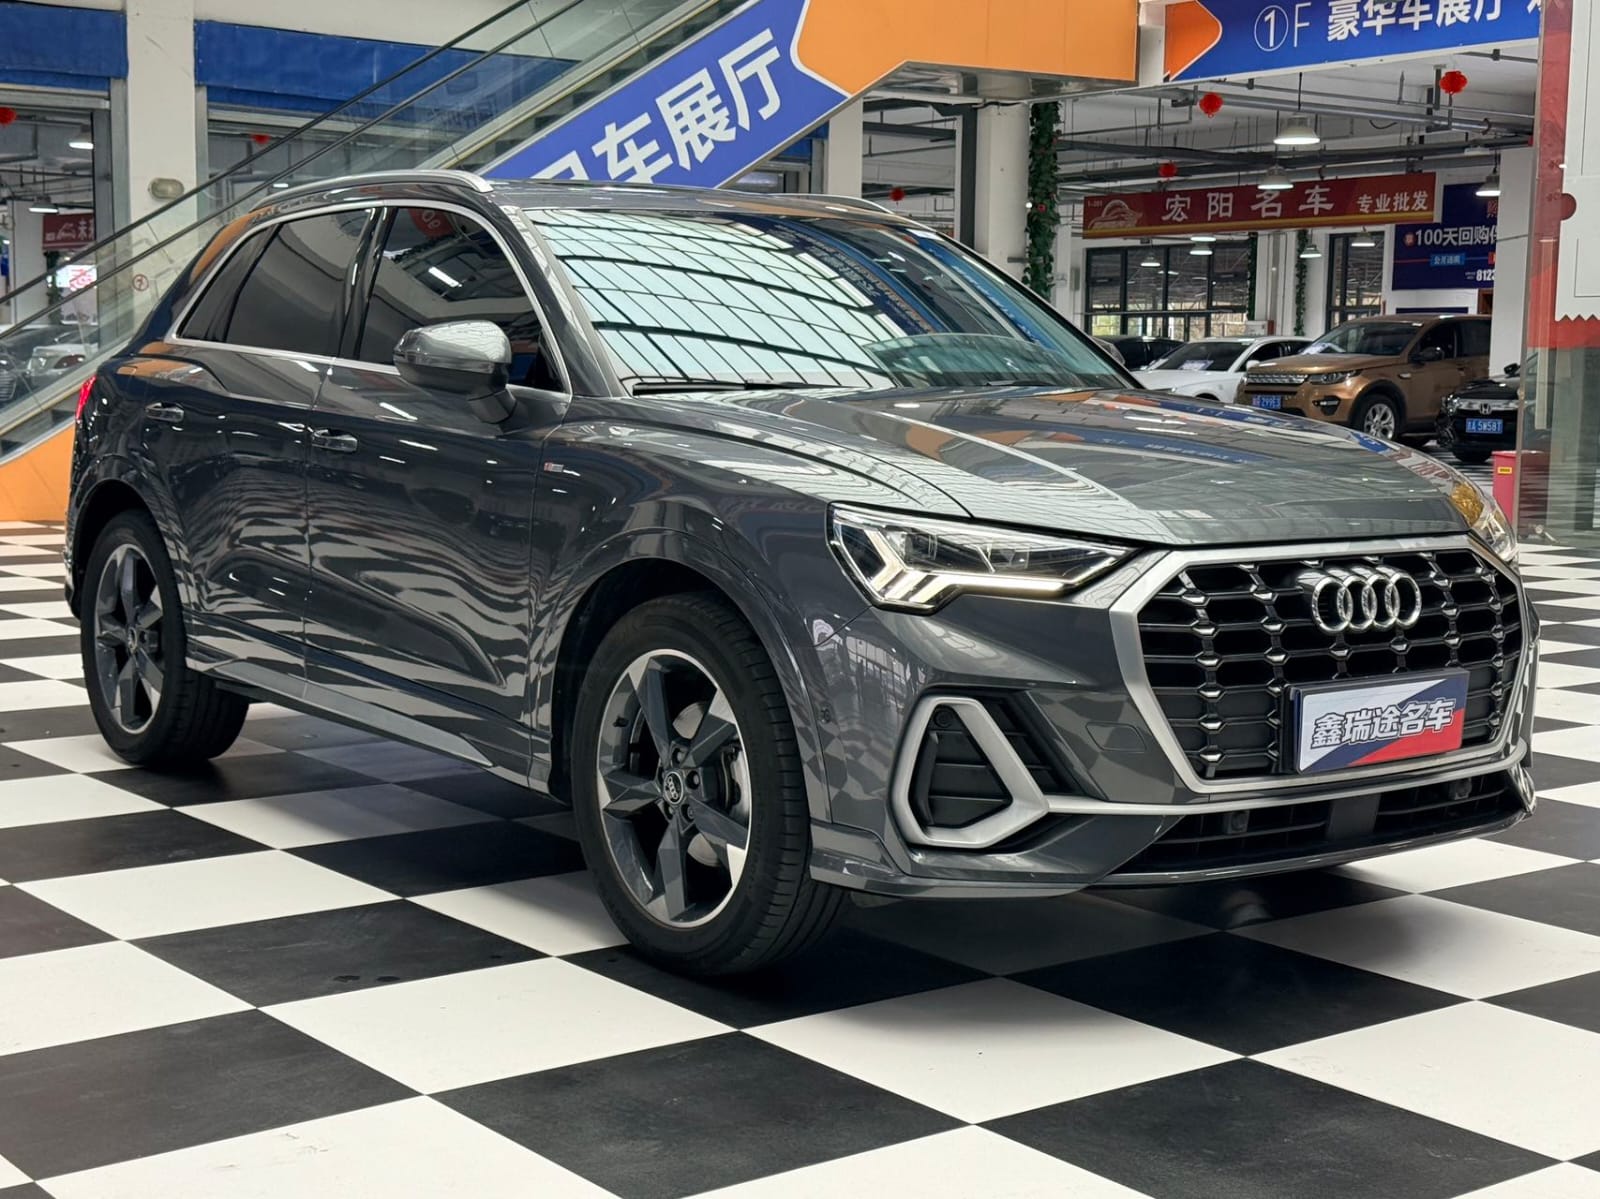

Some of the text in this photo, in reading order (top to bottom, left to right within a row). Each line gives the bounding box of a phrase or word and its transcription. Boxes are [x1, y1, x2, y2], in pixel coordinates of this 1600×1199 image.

[530, 28, 781, 185] 车展厅
[1161, 184, 1430, 222] 宏阳名车 专业批发
[1310, 697, 1456, 749] 鑫瑞途名车
